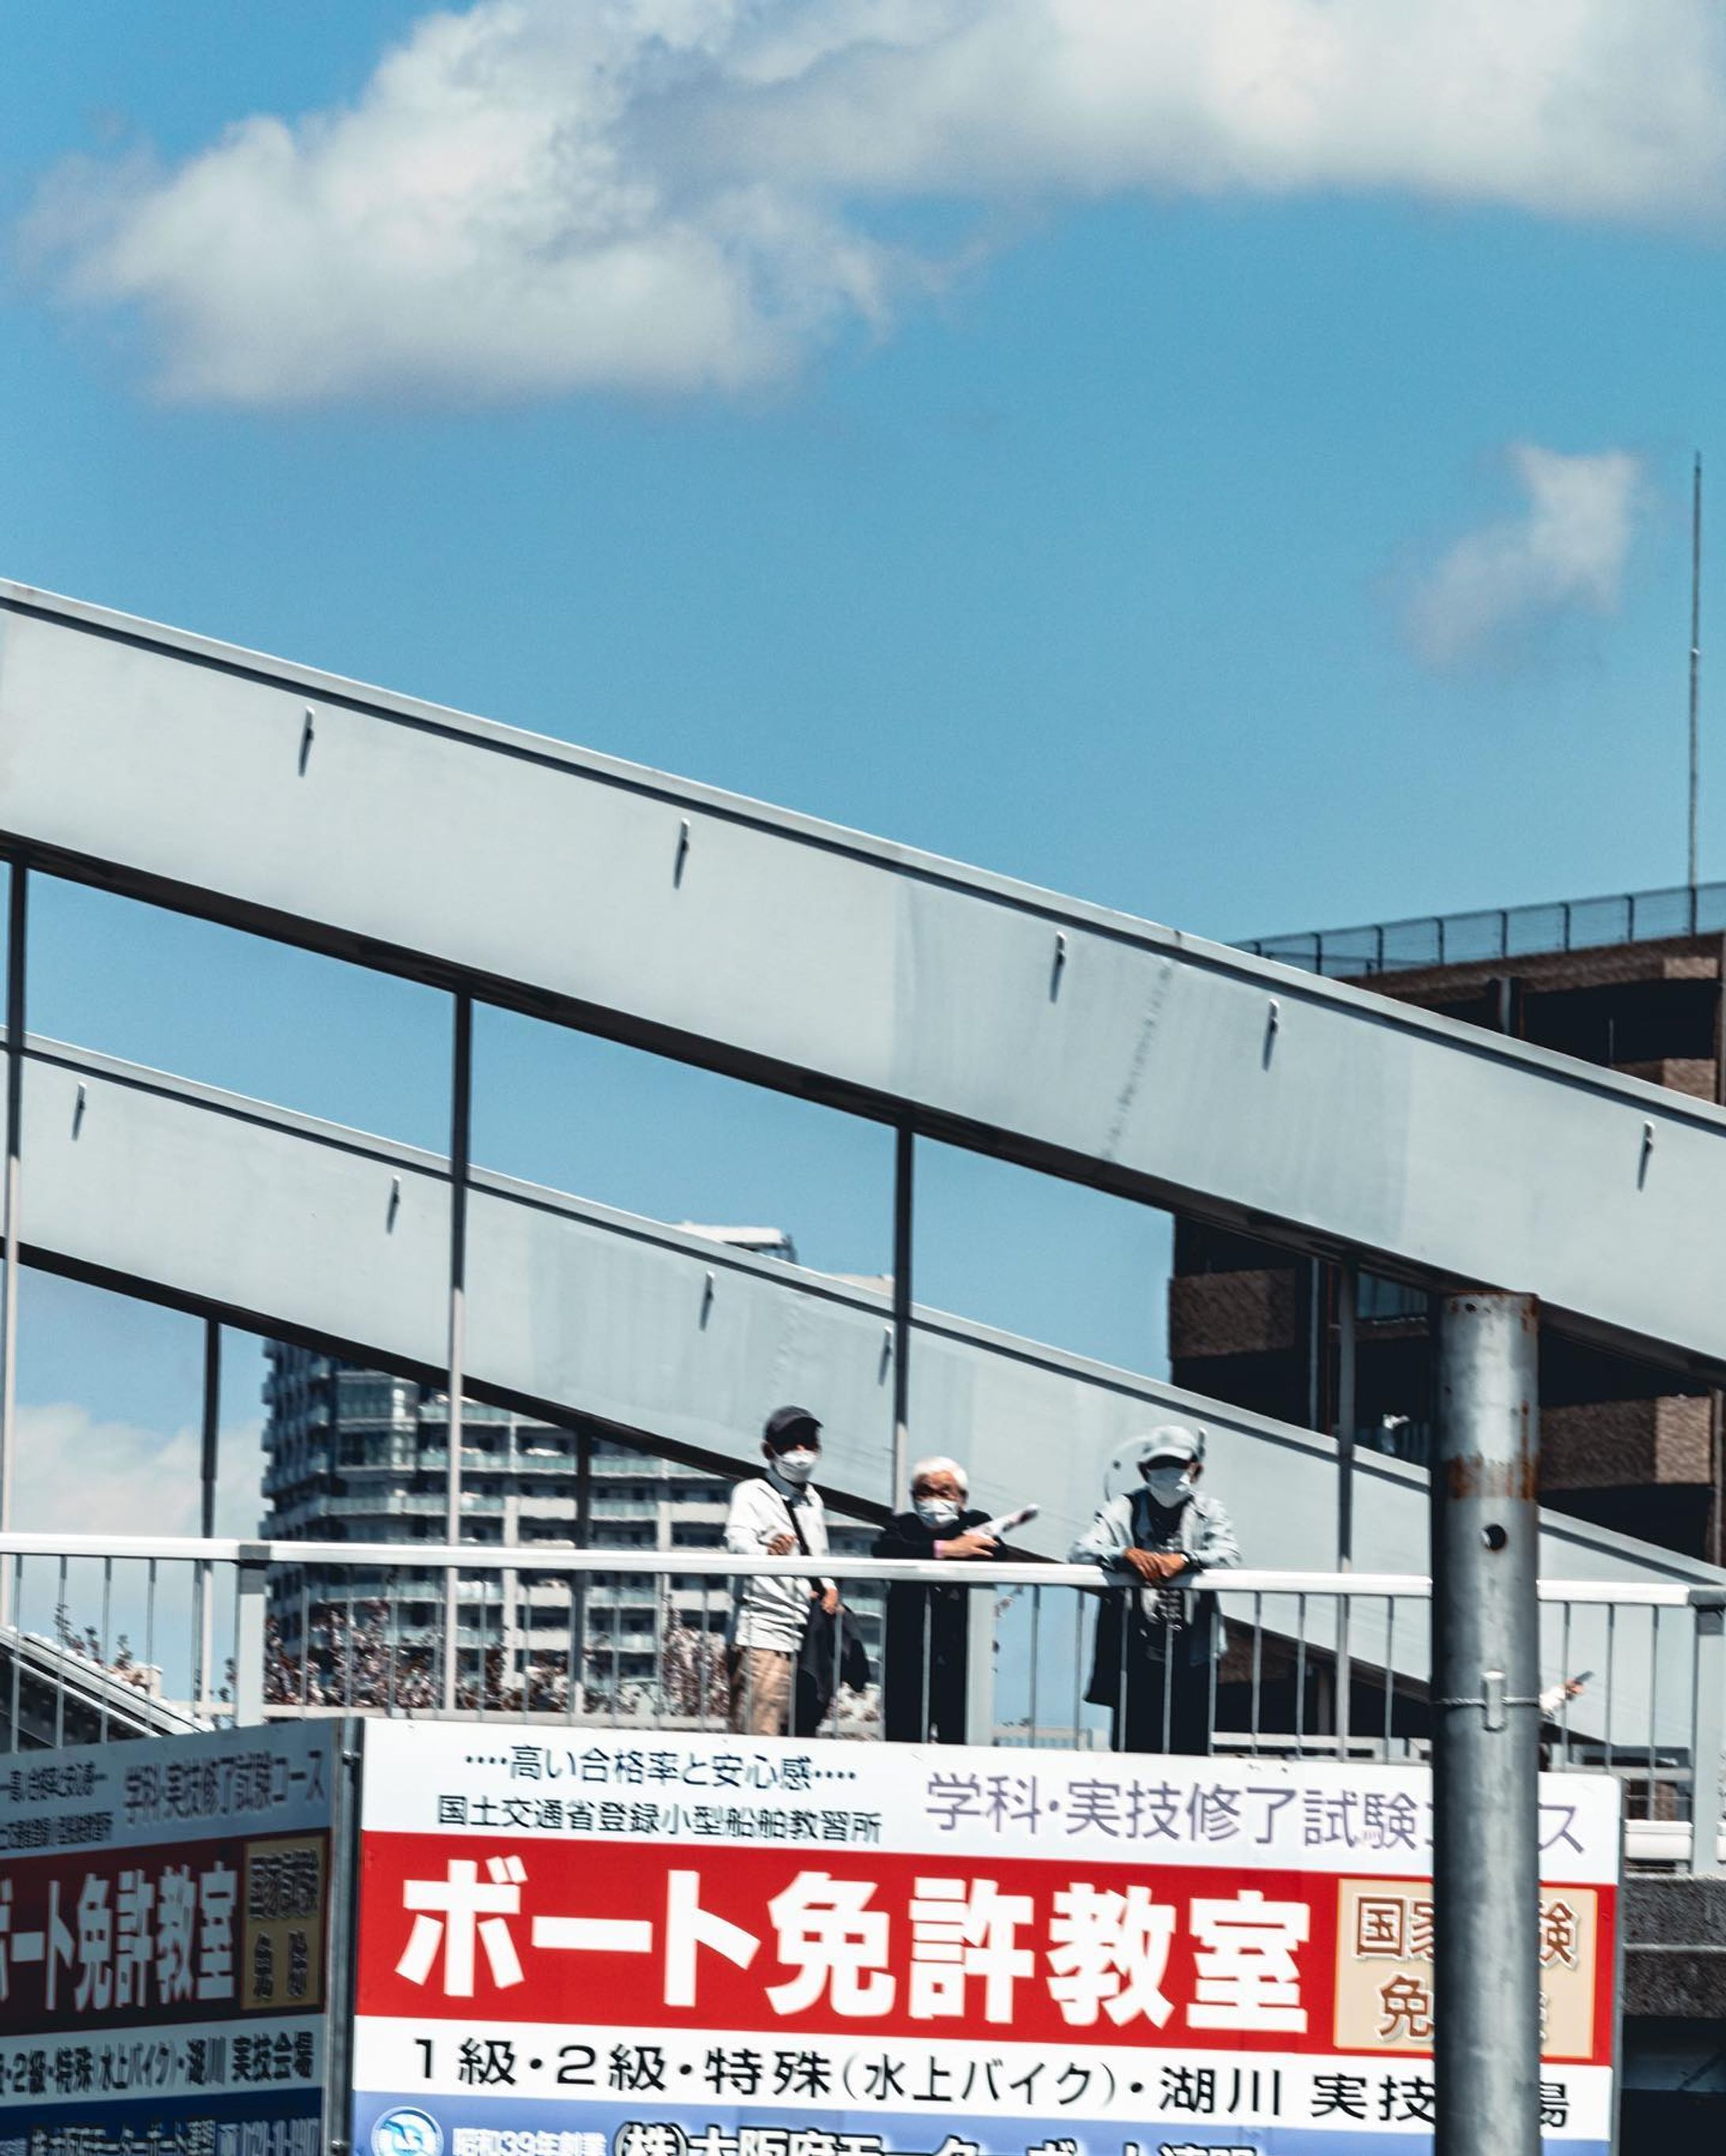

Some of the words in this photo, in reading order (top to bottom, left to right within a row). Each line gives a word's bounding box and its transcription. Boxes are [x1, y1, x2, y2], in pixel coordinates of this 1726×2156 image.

[436, 1794, 882, 1845] 国土交通省登録小型船舶教習所
[925, 1770, 1585, 1854] 学科・実技修了試験ス
[395, 1855, 1310, 2034] ボート免許教室
